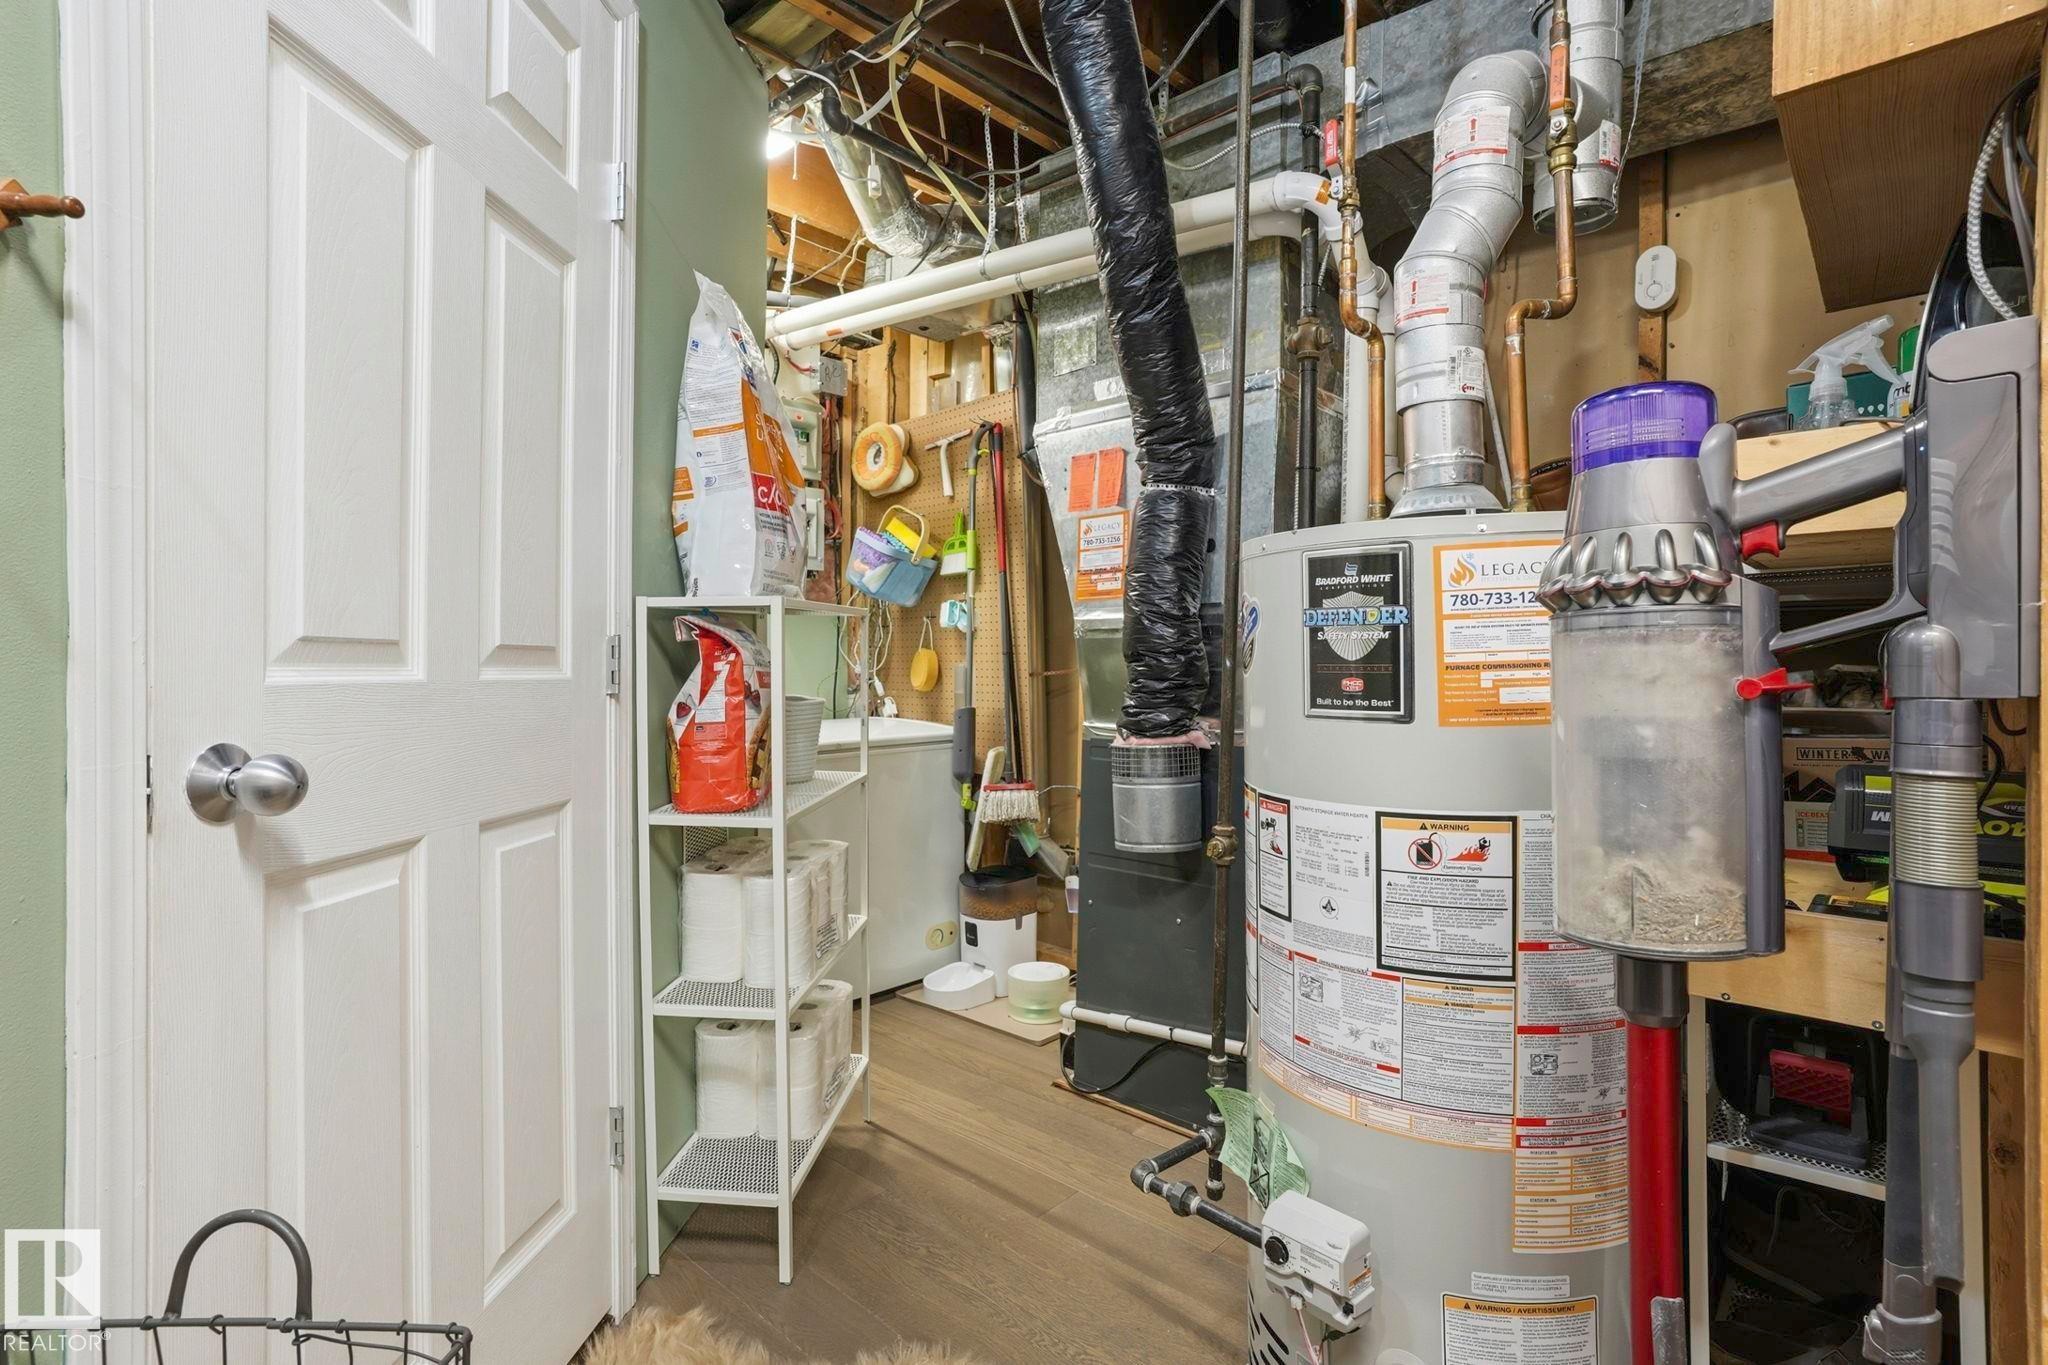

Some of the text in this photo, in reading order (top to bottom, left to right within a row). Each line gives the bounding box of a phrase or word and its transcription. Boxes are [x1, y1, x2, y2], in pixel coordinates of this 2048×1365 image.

[1481, 561, 1548, 577] LEGAC
[1315, 573, 1392, 586] BRADFORD WHITE
[1450, 591, 1537, 607] 780-733-12
[1304, 605, 1409, 627] DEFENDER
[1317, 630, 1391, 641] SAFETY SYSTEM
[1482, 662, 1542, 670] COMMISSIONING
[1316, 697, 1332, 705] Built
[1333, 698, 1342, 706] to
[1343, 698, 1354, 707] be
[1355, 698, 1369, 707] the
[1799, 749, 1891, 760] WINTER WA
[1430, 823, 1470, 832] WARNING
[1475, 1304, 1513, 1314] WARNING
[1516, 1305, 1576, 1315] AVERTISSEMENT
